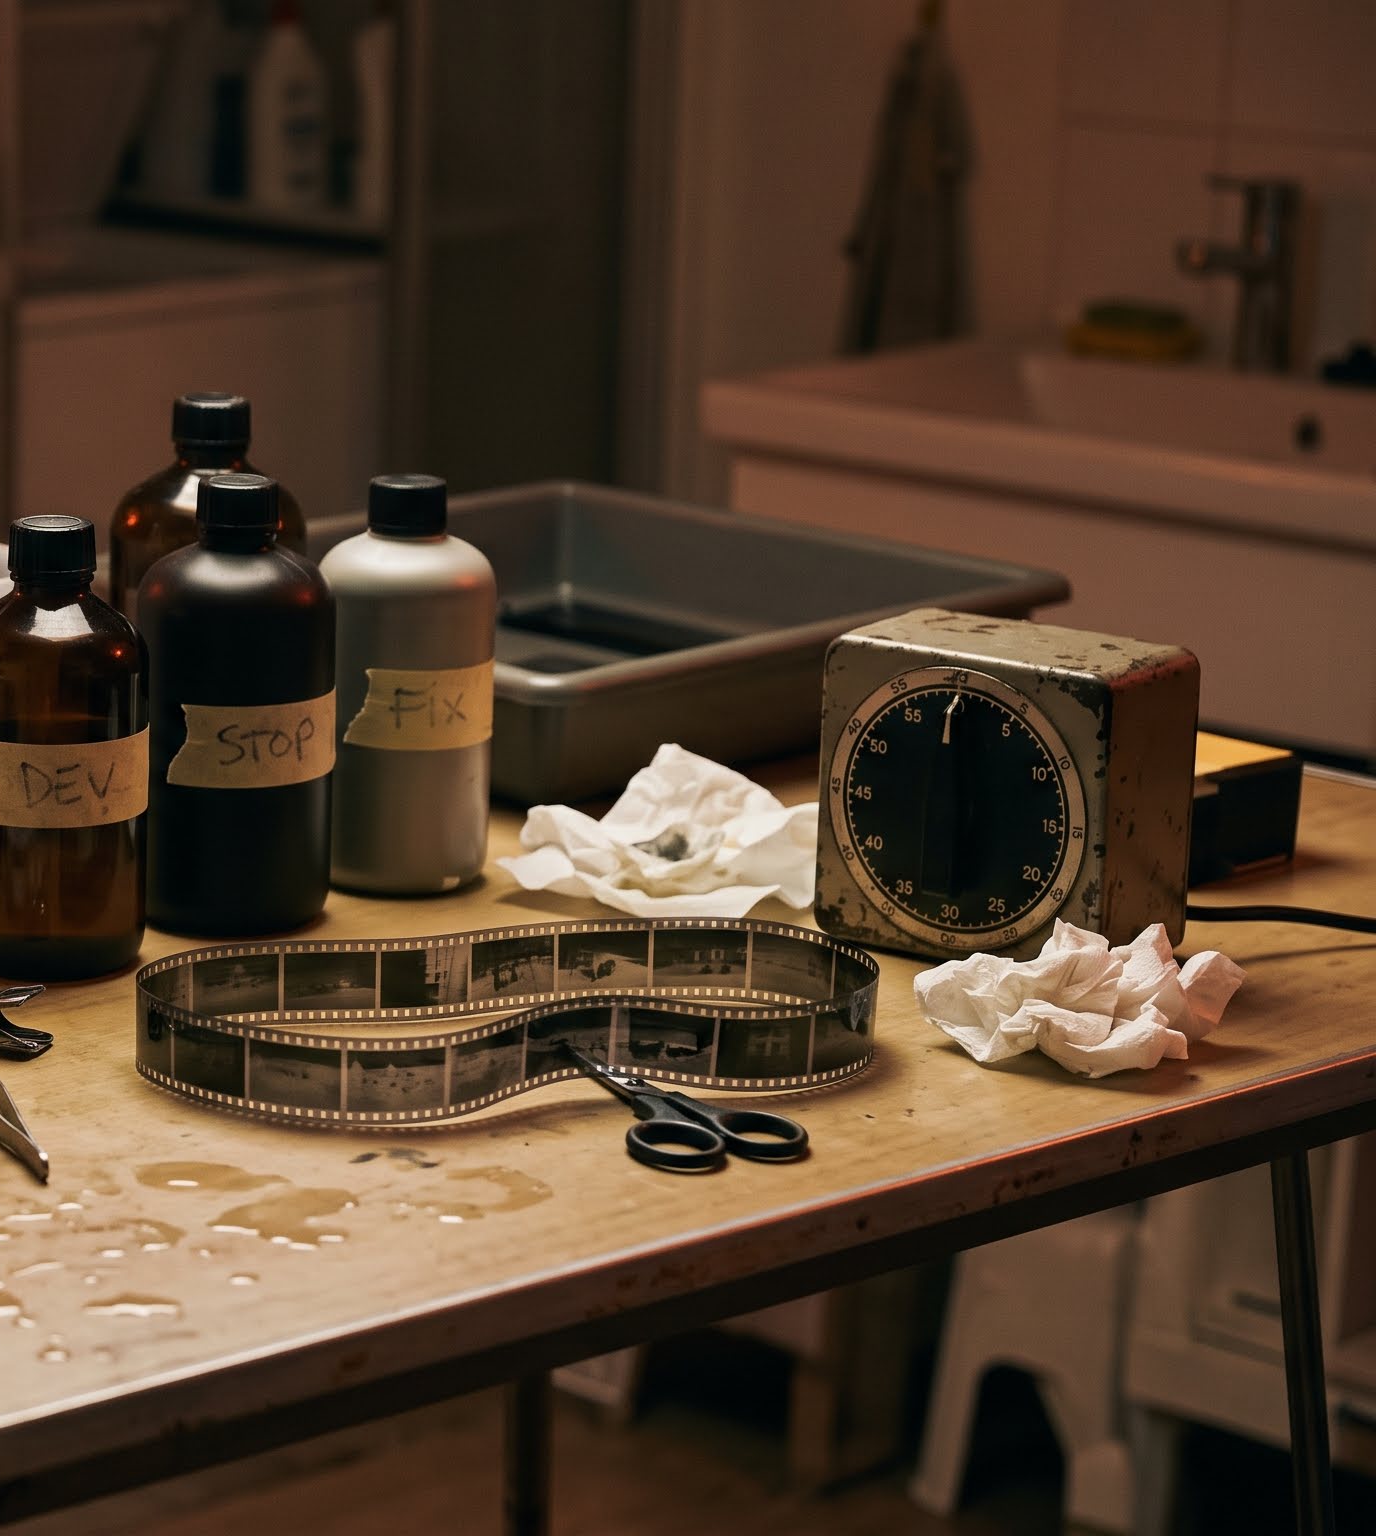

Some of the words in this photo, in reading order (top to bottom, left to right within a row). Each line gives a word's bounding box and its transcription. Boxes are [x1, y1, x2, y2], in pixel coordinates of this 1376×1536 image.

[890, 679, 908, 694] 55
[389, 681, 467, 729] FIX
[904, 708, 922, 722] 55
[847, 718, 863, 735] 40
[1001, 724, 1011, 737] 5
[217, 717, 316, 766] STOP
[869, 740, 888, 753] 50
[1058, 756, 1071, 770] 10
[1032, 766, 1047, 781] 10
[831, 777, 842, 795] 45
[854, 785, 872, 800] 45
[1042, 819, 1057, 834] 15
[865, 835, 883, 850] 40
[1022, 866, 1041, 882] 20
[895, 880, 913, 895] 35
[940, 904, 959, 919] 30
[988, 897, 1006, 913] 25
